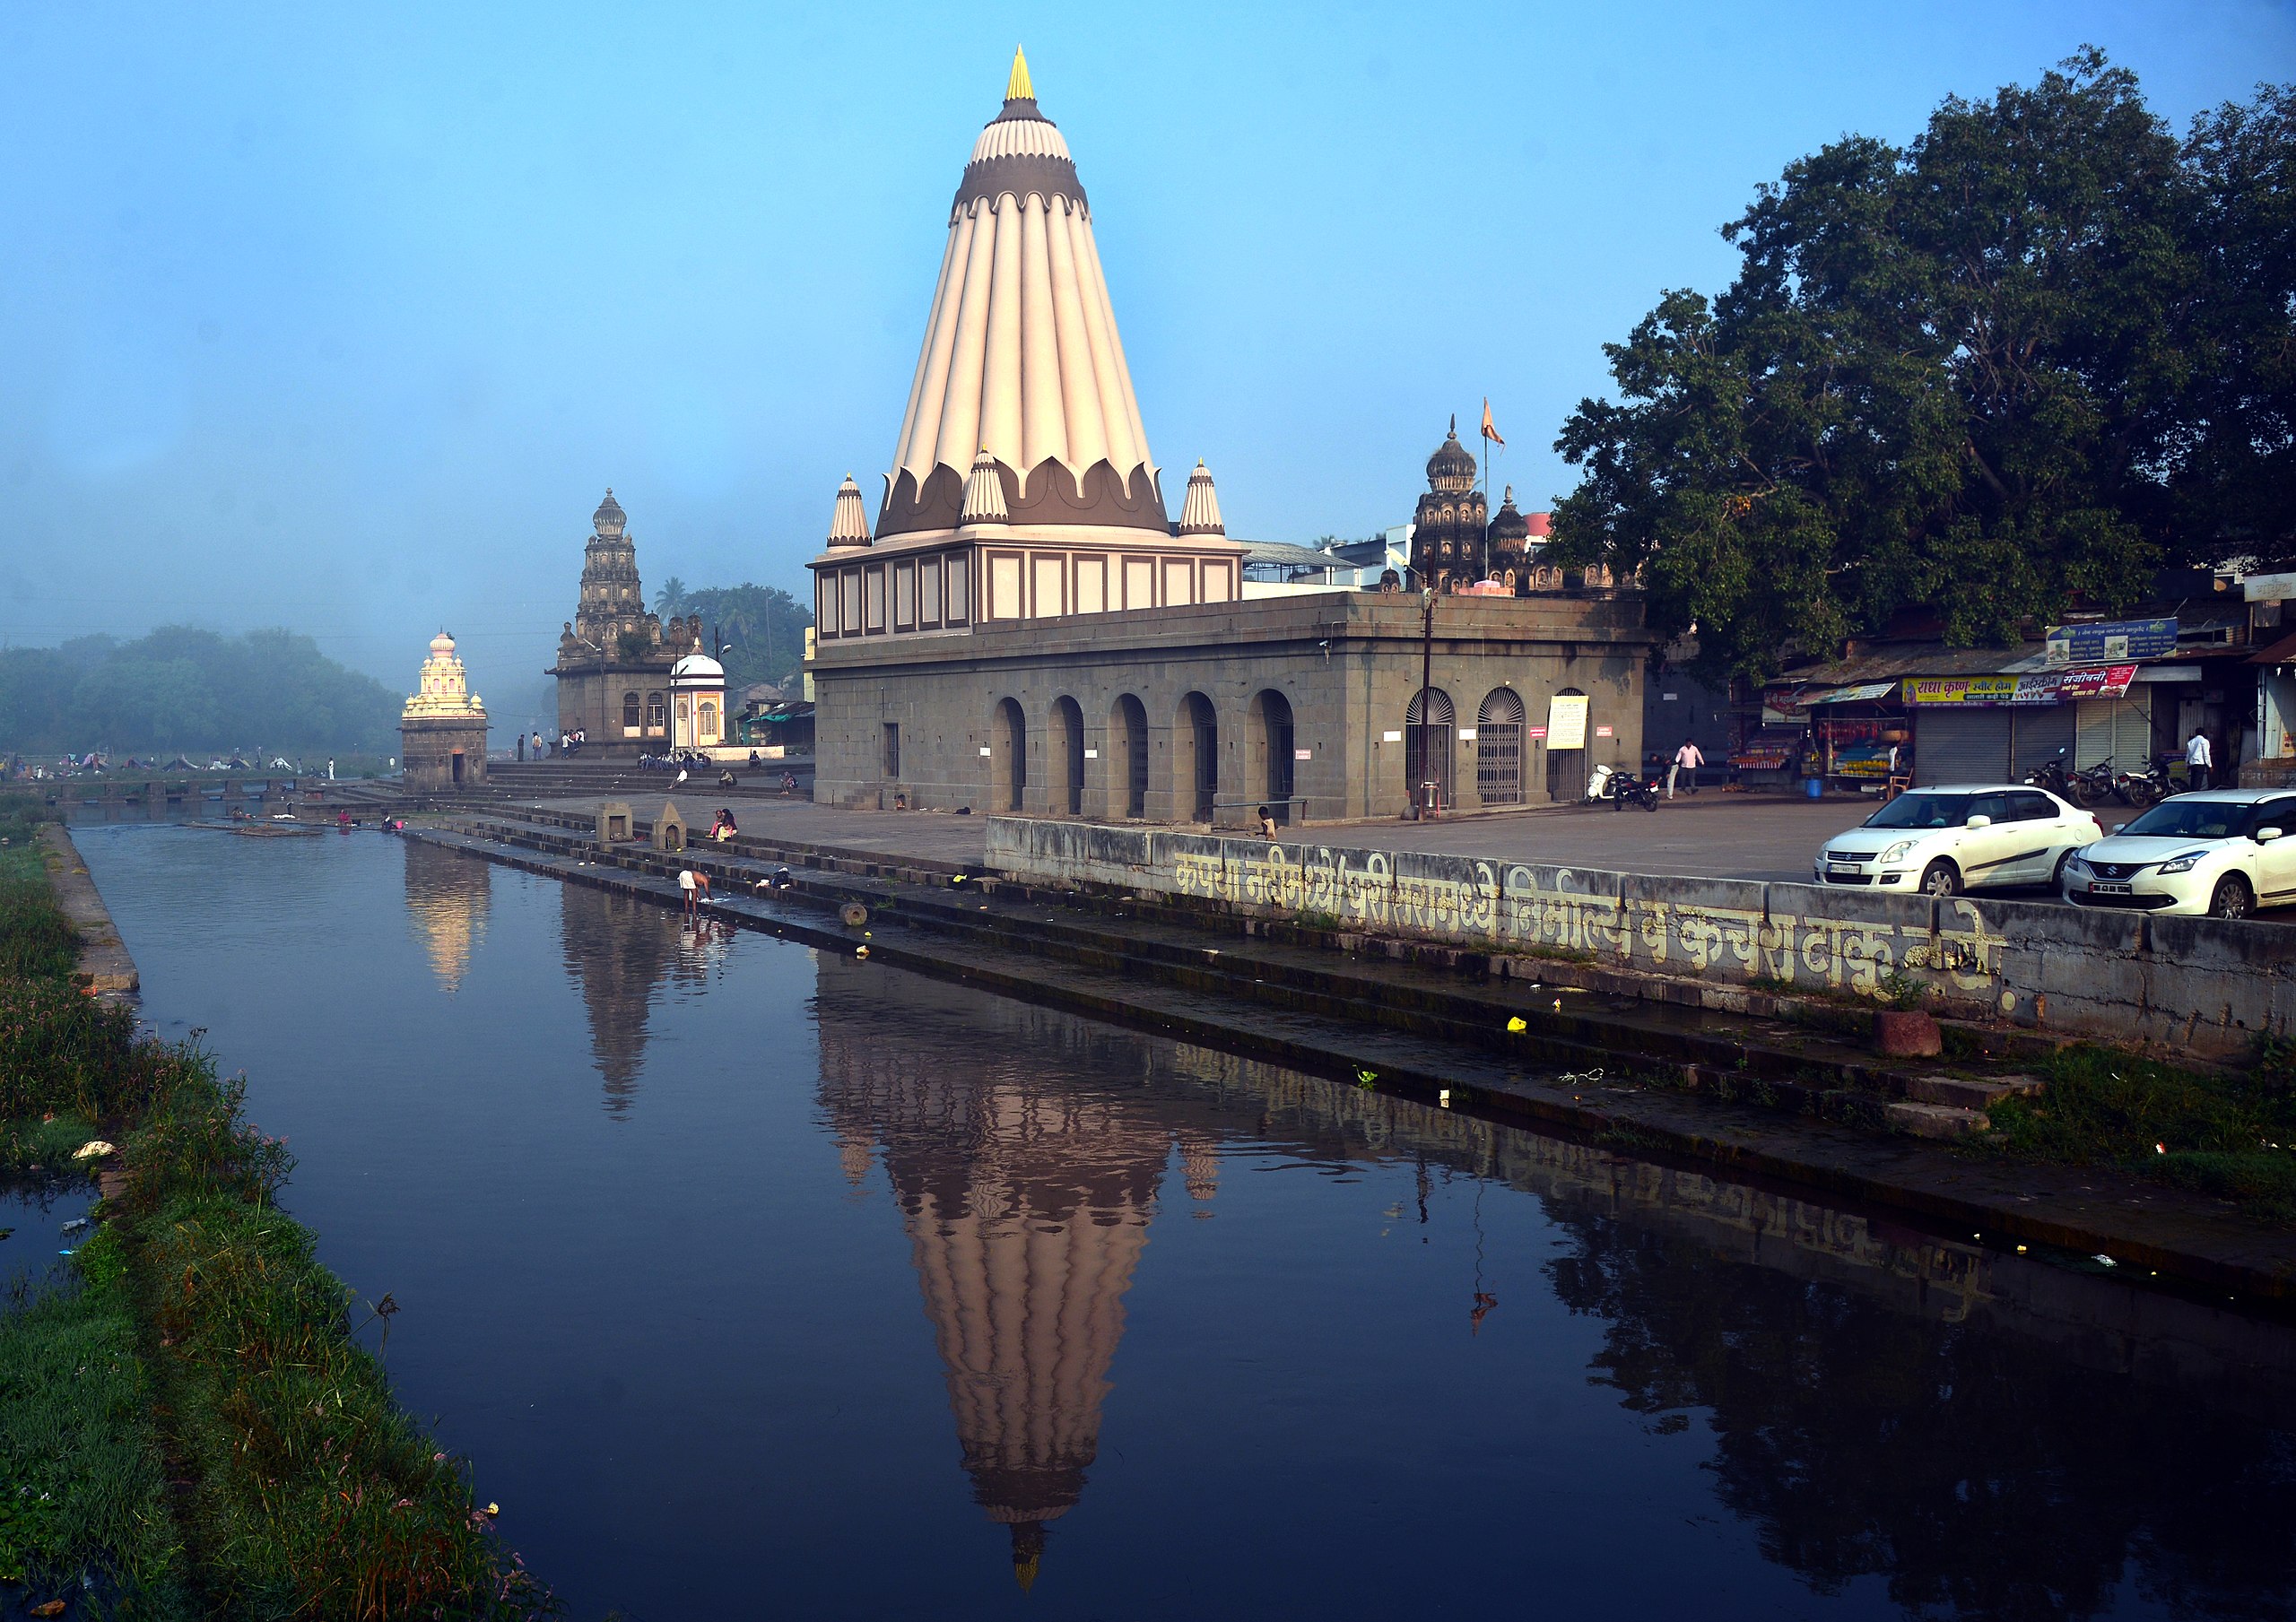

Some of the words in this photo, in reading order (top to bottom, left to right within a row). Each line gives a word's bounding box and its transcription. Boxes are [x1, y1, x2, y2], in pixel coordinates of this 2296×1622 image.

[2018, 676, 2057, 691] आईस्क्रीम
[2063, 671, 2107, 684] संजीवनी
[1918, 681, 1942, 693] राधा
[1944, 681, 1970, 698] कृष्ण
[1972, 681, 1993, 691] स्वीट
[1995, 680, 2011, 691] होम
[1638, 898, 1670, 964] व
[1674, 903, 1798, 984] कचरा
